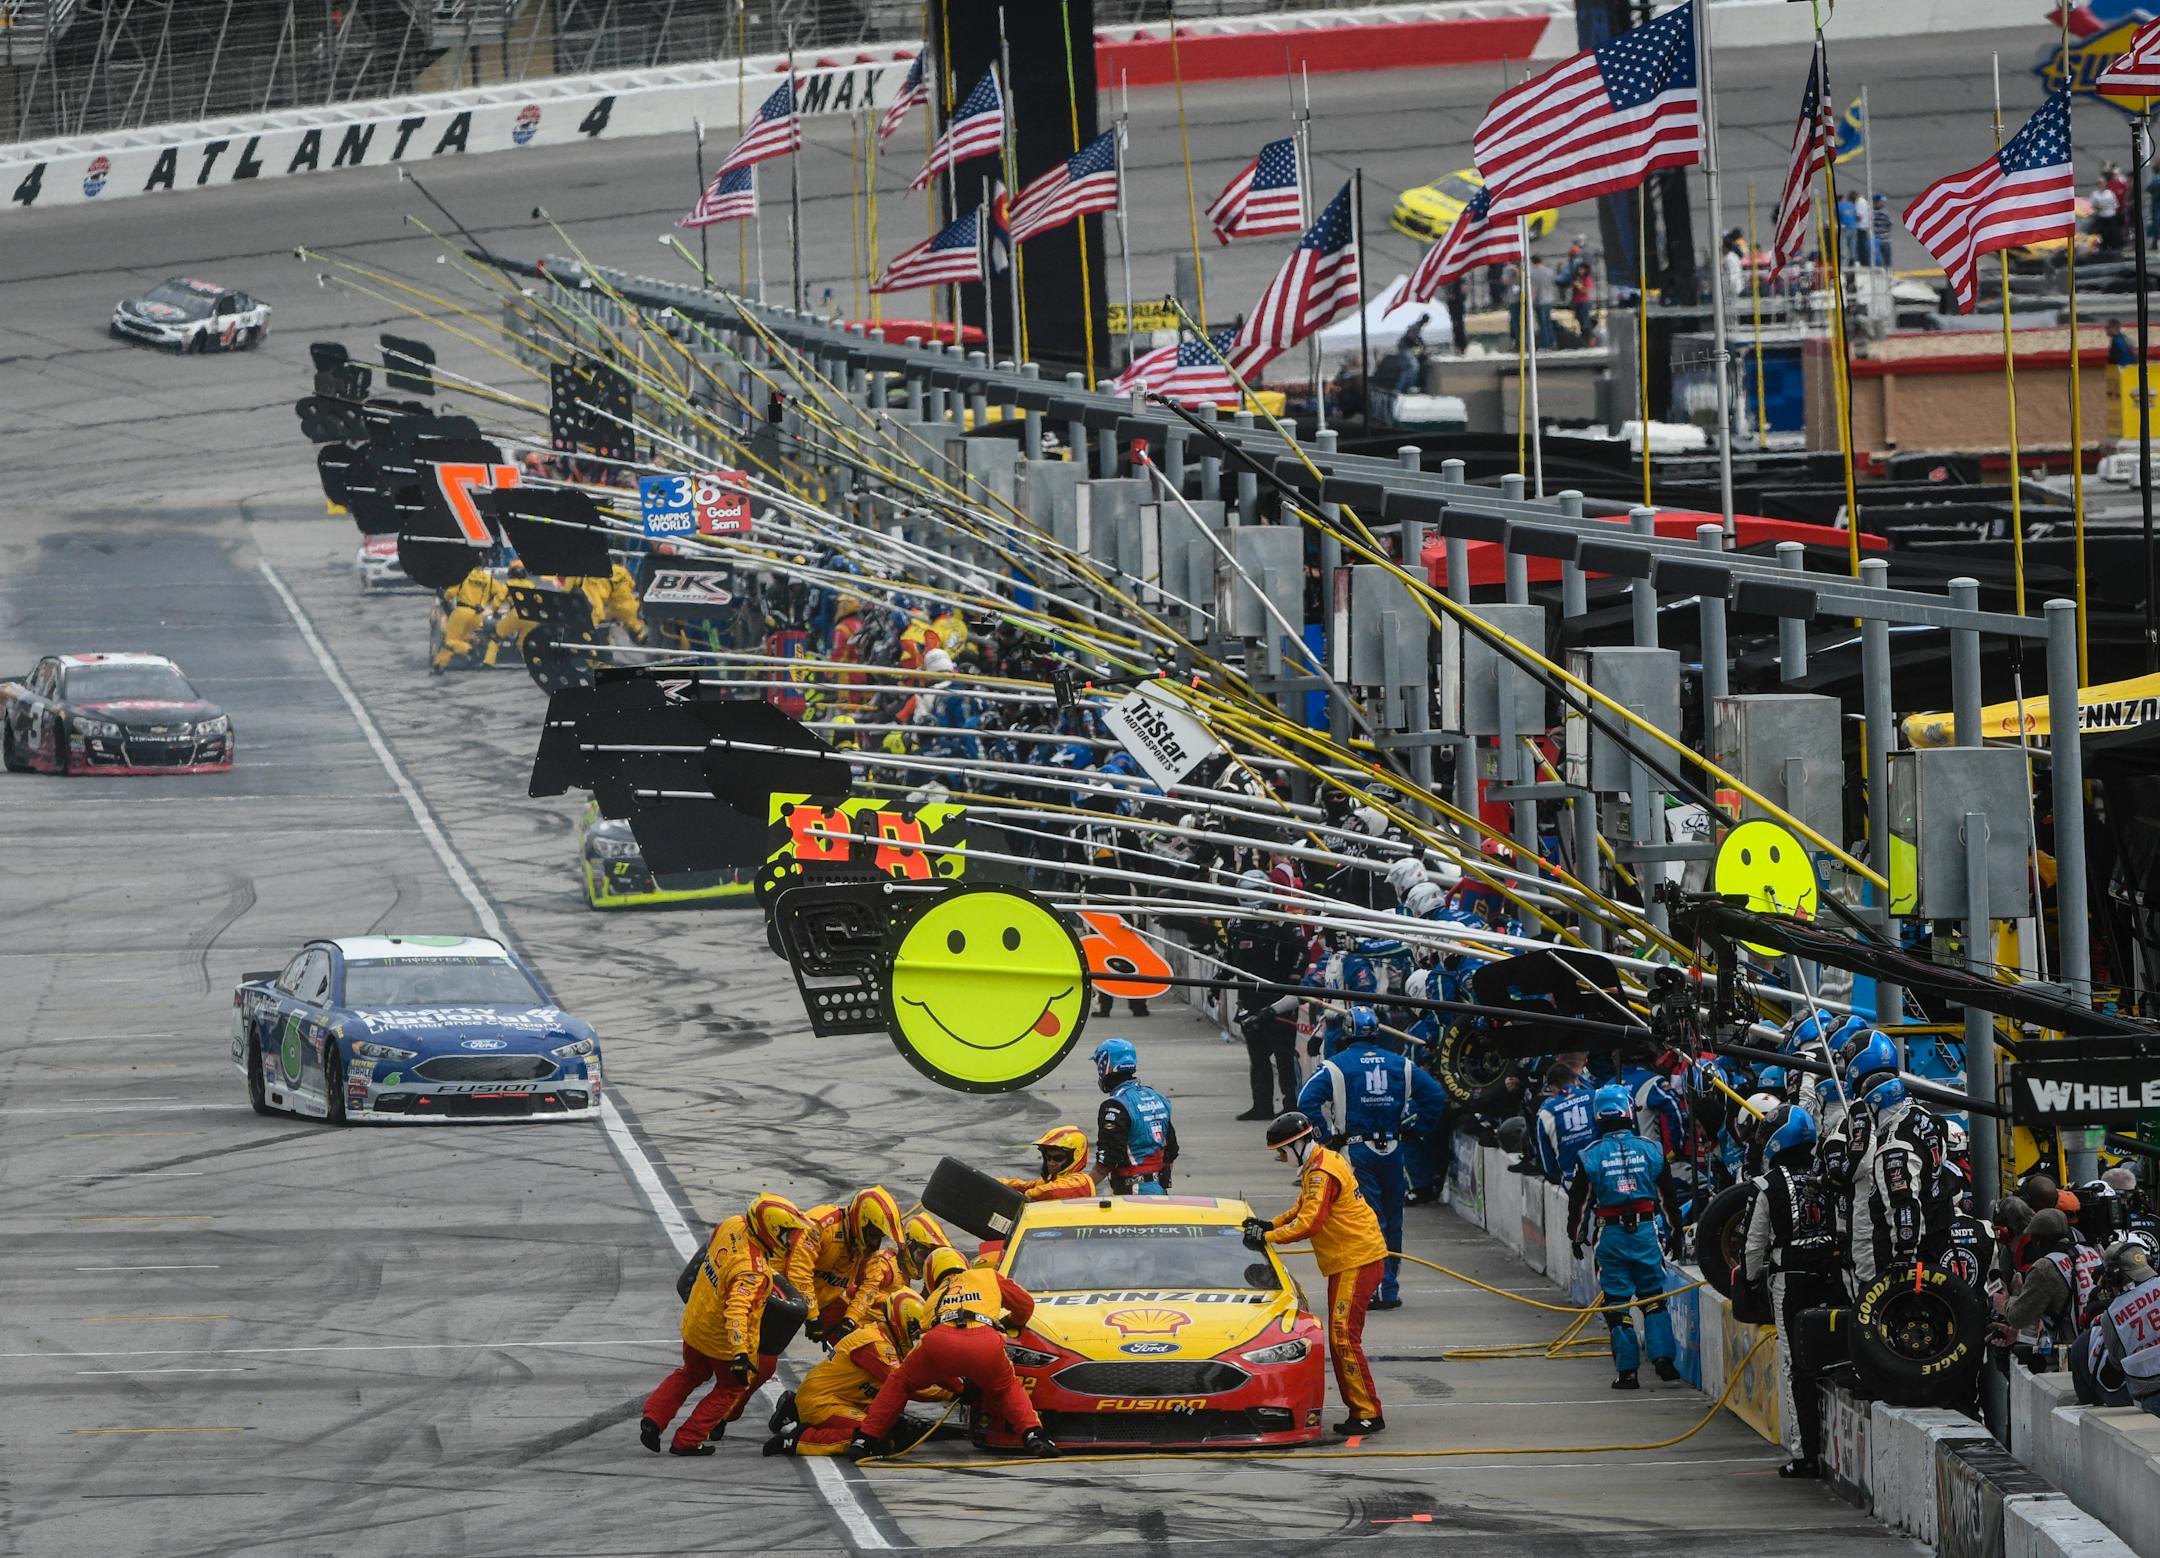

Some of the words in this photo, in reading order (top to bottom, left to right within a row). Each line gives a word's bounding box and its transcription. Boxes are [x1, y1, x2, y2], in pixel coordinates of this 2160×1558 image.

[12, 162, 47, 206] 4
[142, 108, 474, 192] ATLANTA
[578, 96, 627, 138] 4
[647, 511, 690, 523] CAMPING
[706, 505, 742, 518] Good
[648, 519, 691, 532] WORLD
[721, 519, 740, 531] Sam
[1130, 697, 1188, 763] TriStar
[1123, 714, 1174, 771] MOTORSPORTS
[614, 862, 630, 875] 27
[355, 1007, 497, 1020] Liberty
[361, 1012, 529, 1028] National
[369, 1024, 404, 1035] Life
[405, 1020, 482, 1031] Insurance
[486, 1020, 562, 1030] Company
[467, 1039, 500, 1048] Ford
[437, 1084, 537, 1093] FUSION
[1099, 1226, 1181, 1235] MONSTER
[1131, 1342, 1170, 1355] Ford
[1921, 1342, 1968, 1376] EAGLE
[1096, 1399, 1208, 1411] FUSION
